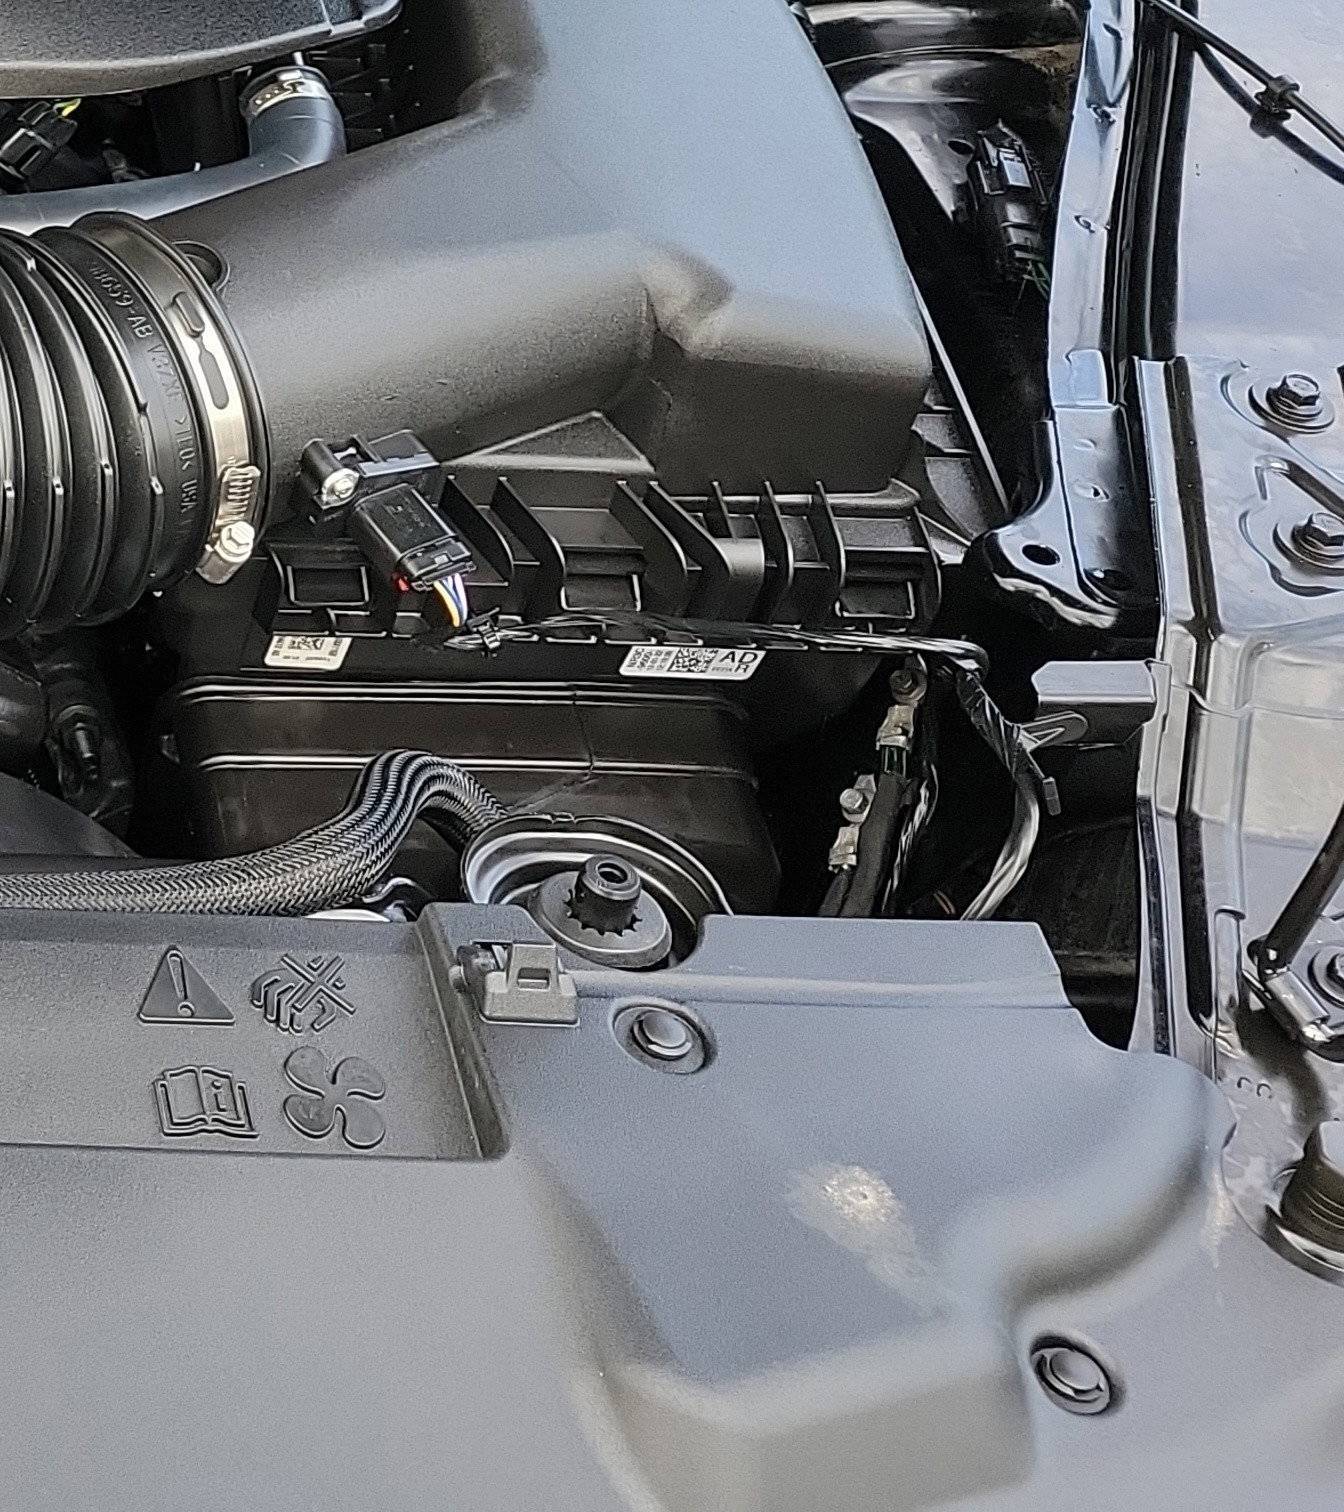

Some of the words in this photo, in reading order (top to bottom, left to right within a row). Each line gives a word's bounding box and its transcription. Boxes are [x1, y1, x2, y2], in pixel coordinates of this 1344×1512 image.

[181, 479, 198, 513] USA
[720, 650, 759, 664] AD
[735, 664, 750, 673] R
